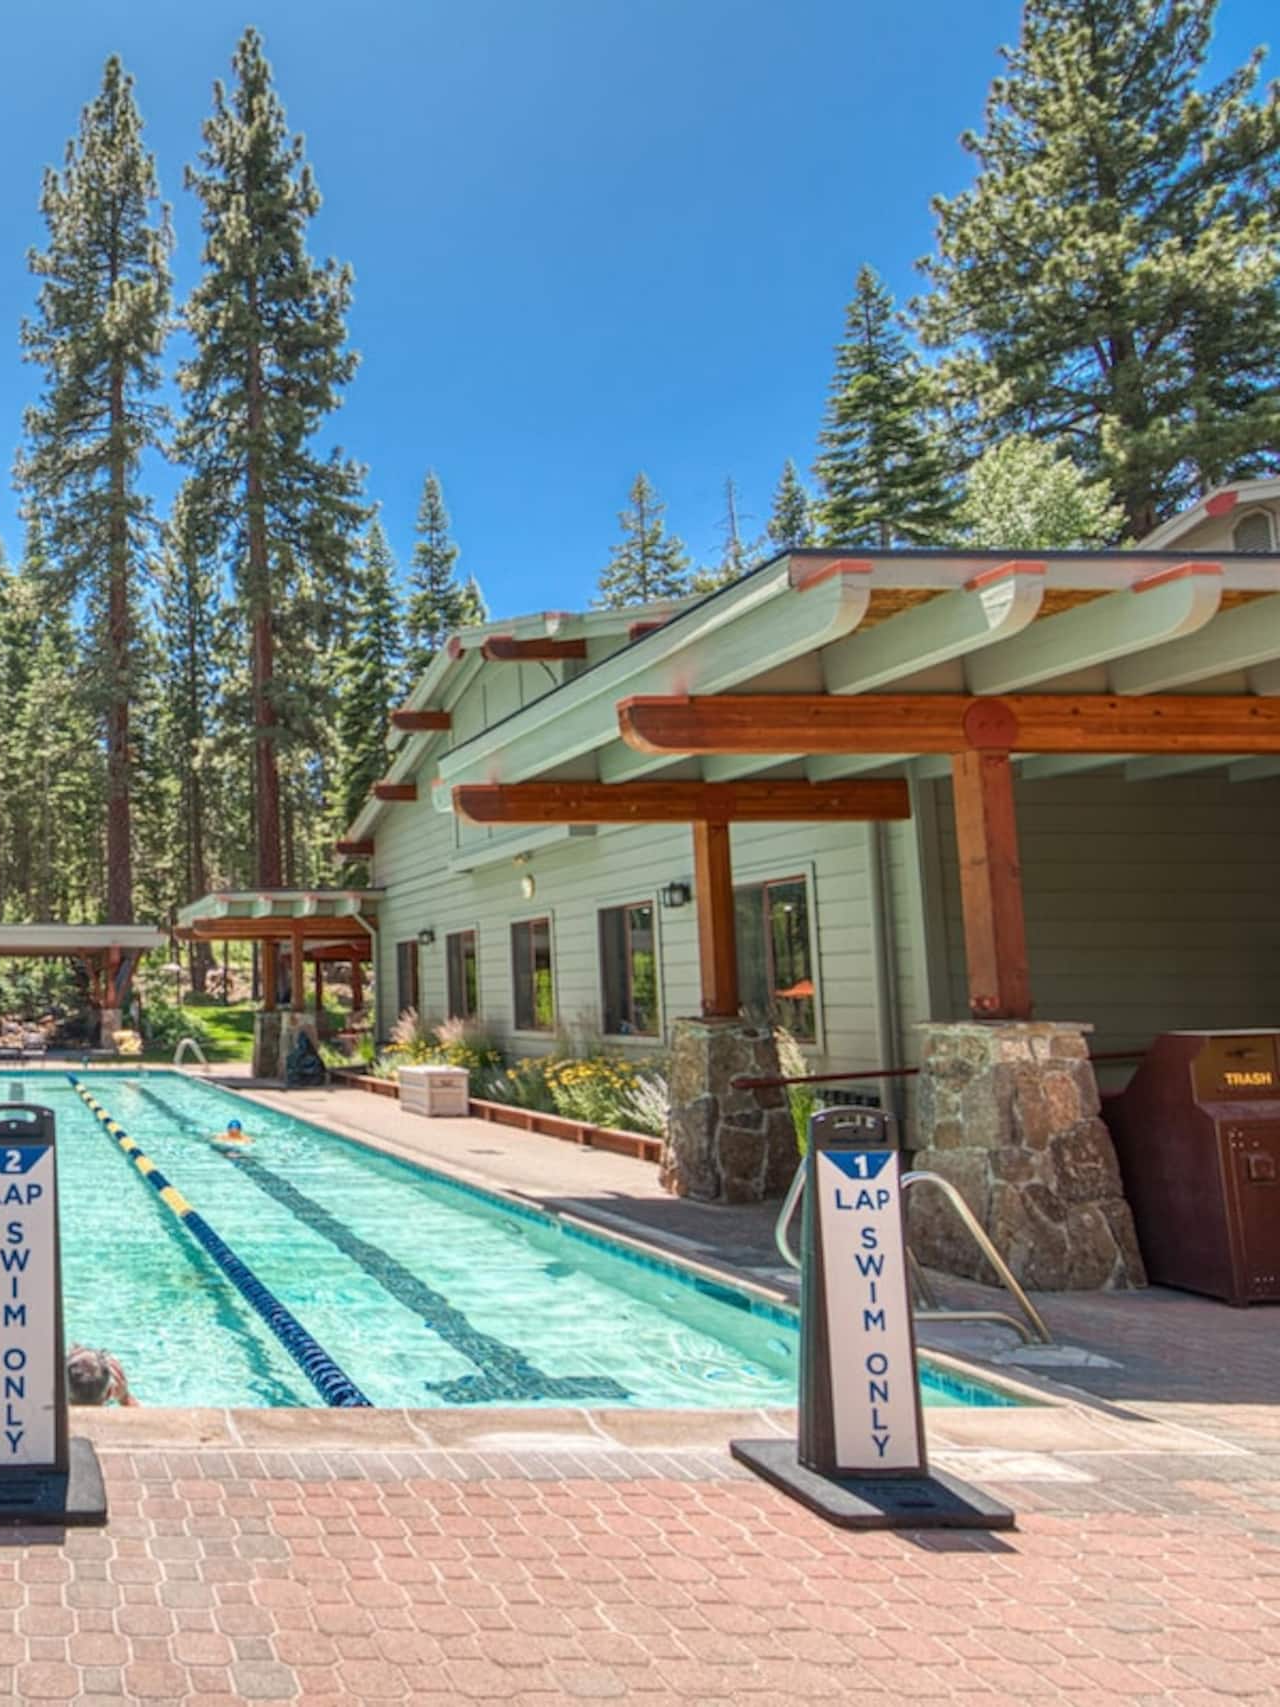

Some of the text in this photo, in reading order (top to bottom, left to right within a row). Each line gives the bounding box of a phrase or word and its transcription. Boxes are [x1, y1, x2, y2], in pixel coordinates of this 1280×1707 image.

[1224, 1072, 1272, 1086] TRASH
[5, 1150, 21, 1172] 2
[853, 1155, 868, 1178] 1
[835, 1189, 890, 1210] LAP
[0, 1221, 31, 1454] SWIM ONLY
[855, 1227, 889, 1458] SWIM ONLY
